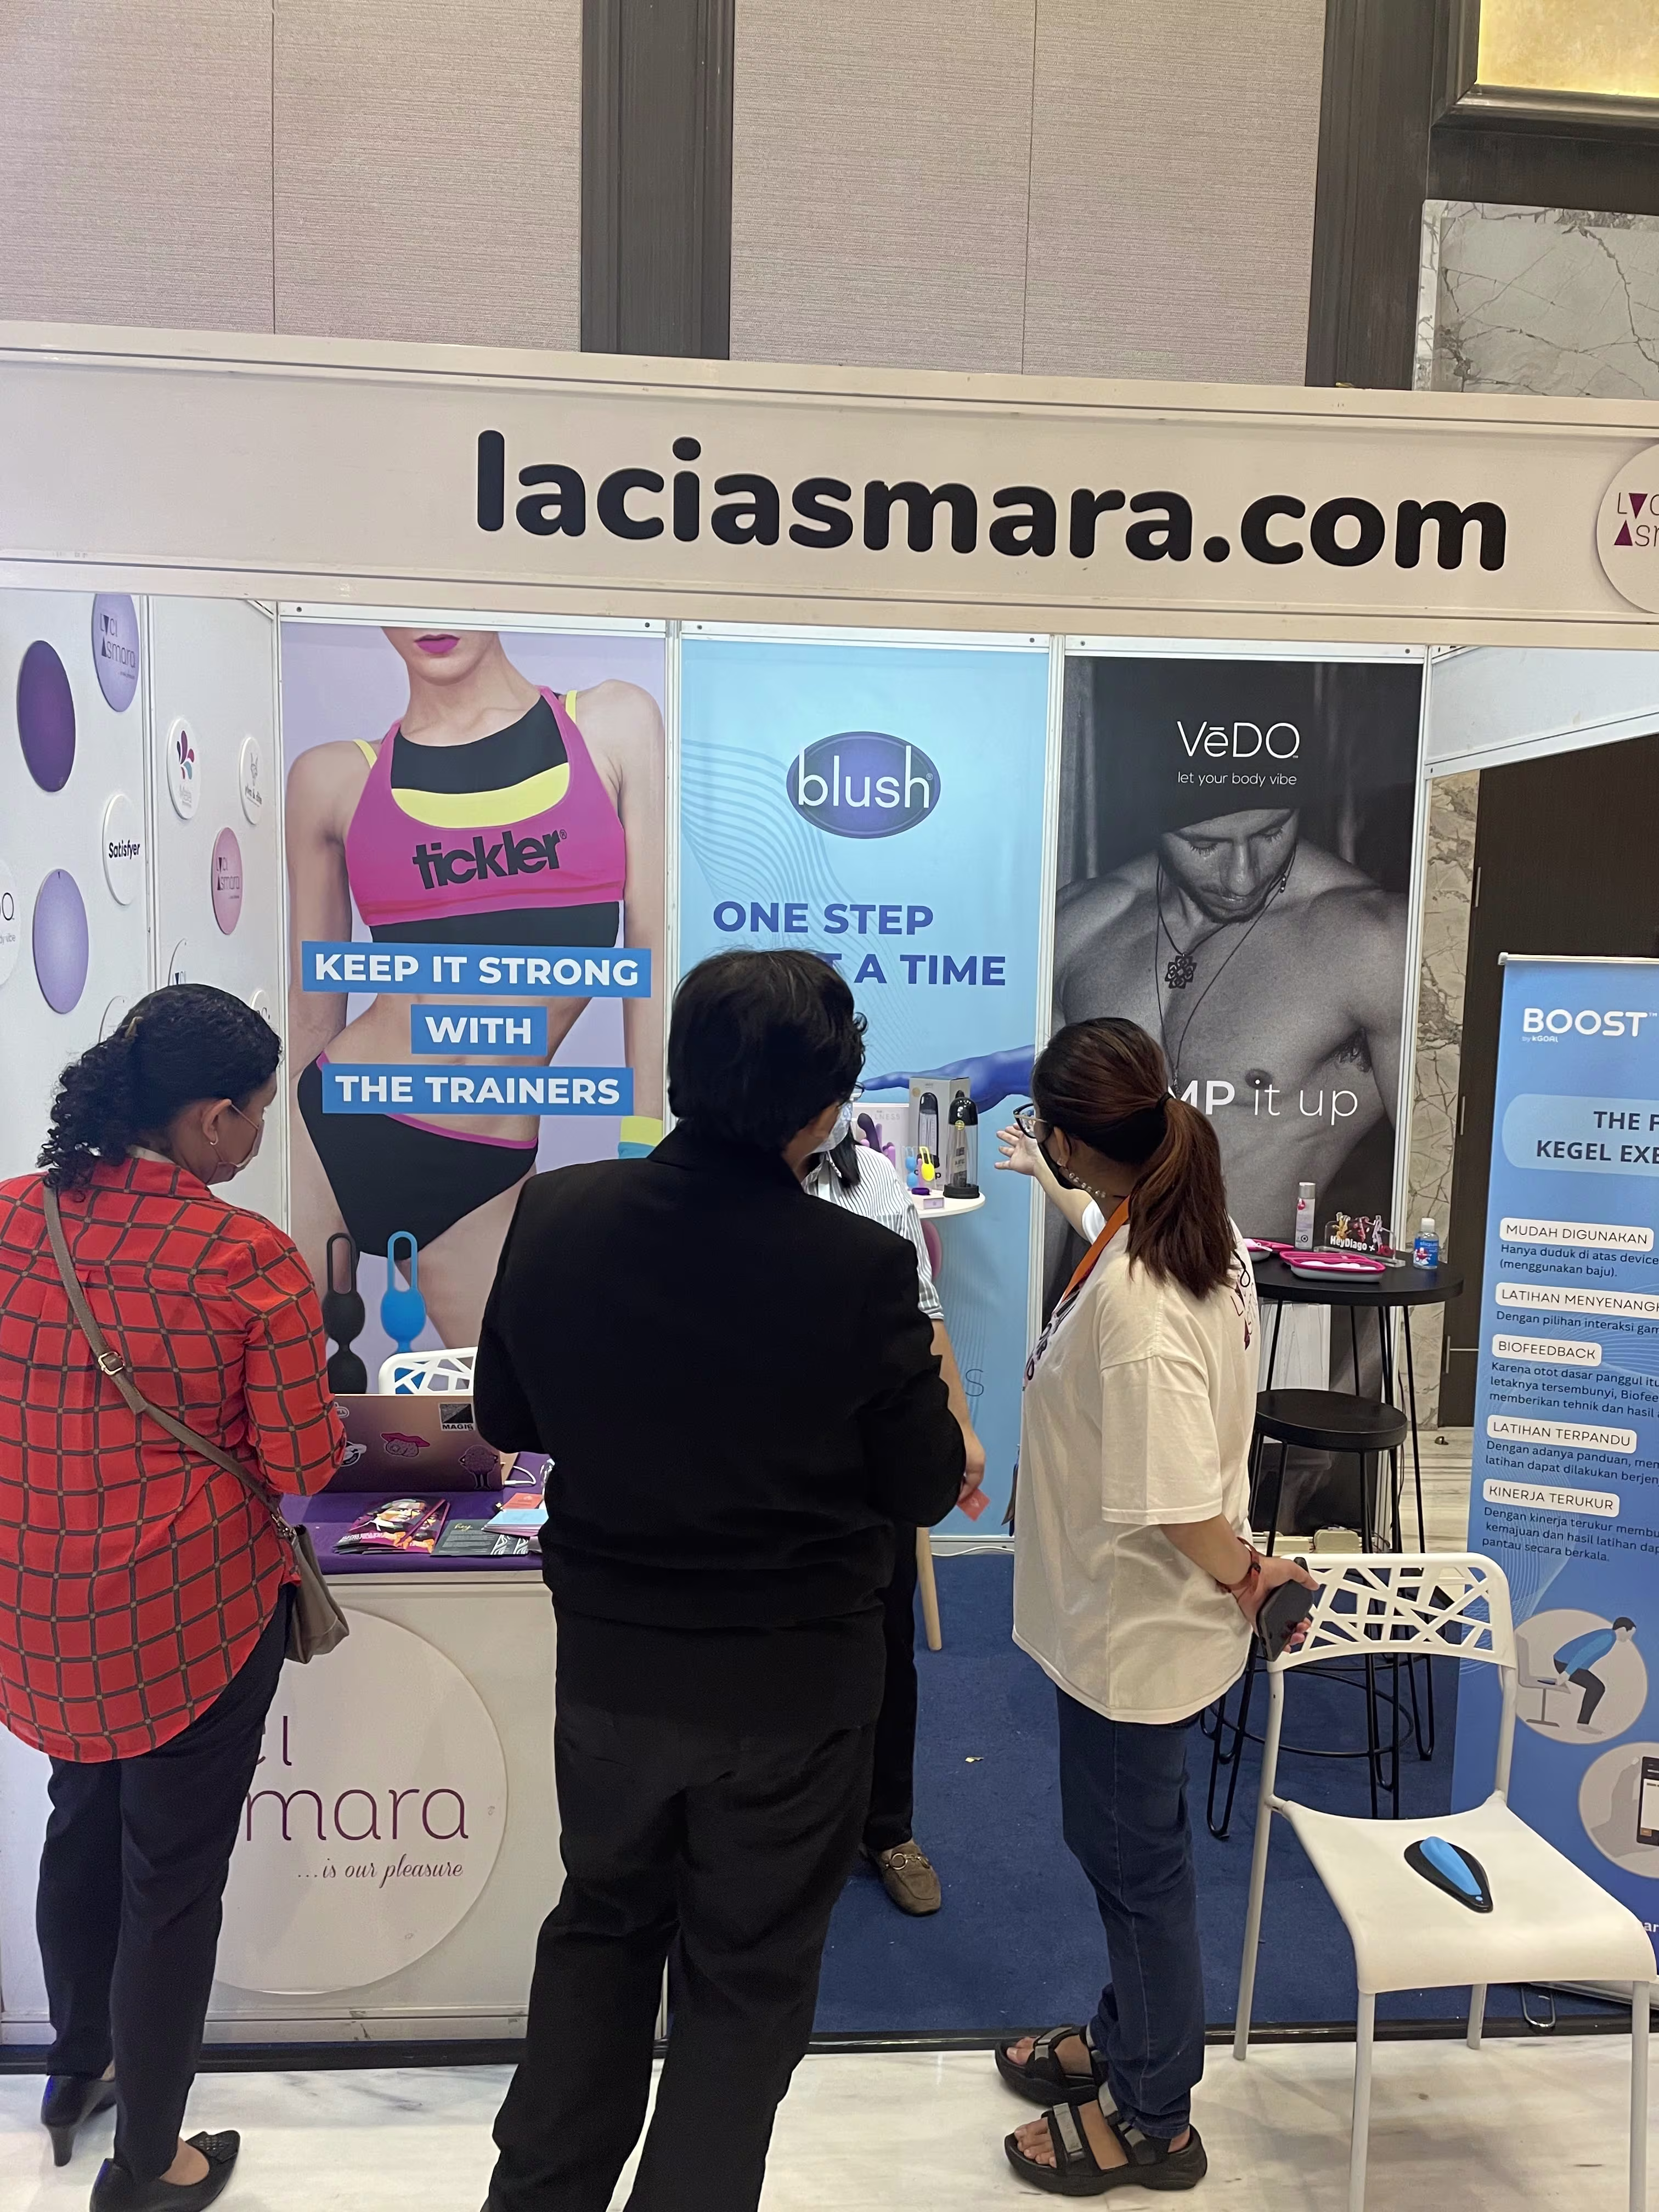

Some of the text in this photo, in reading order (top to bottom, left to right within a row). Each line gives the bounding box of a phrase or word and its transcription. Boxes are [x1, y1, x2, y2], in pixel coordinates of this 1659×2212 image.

[477, 430, 1506, 571] laciasmara.com
[1177, 771, 1297, 787] let your body vibe
[109, 839, 140, 860] Satisfyer
[713, 901, 933, 935] ONE STEP
[315, 953, 639, 986] KEEP IT STRONG
[854, 953, 888, 984] A
[900, 954, 1006, 986] TIME
[425, 1016, 532, 1044] WITH
[335, 1075, 620, 1105] THE TRAINERS
[1253, 1079, 1280, 1116] it
[1299, 1090, 1358, 1125] up
[1593, 1110, 1641, 1131] THE
[1536, 1140, 1611, 1161] KEGEL
[1506, 1224, 1647, 1244] MUDAH DIGUNAKAN
[1501, 1244, 1659, 1265] Hanya duduk di atas device
[1500, 1259, 1618, 1278] (menggunakan baju).
[1502, 1289, 1659, 1312] LATIHAN MENYENANG
[1497, 1311, 1540, 1325] Dengan
[1543, 1315, 1581, 1327] pilihan
[1585, 1318, 1634, 1331] interaksi
[1499, 1341, 1595, 1359] BIOFEEDBACK
[1492, 1362, 1531, 1374] Karena
[1534, 1367, 1558, 1377] otot
[1561, 1369, 1593, 1380] dasar
[1596, 1373, 1643, 1386] panggul
[1491, 1376, 1659, 1402] letaknya tersembunyi, Biofee
[1489, 1393, 1560, 1408] memberikan
[1563, 1400, 1599, 1412] tehnik
[1601, 1403, 1623, 1414] dan
[1627, 1406, 1654, 1418] hasil
[1493, 1421, 1630, 1446] LATIHAN TERPANDU
[1486, 1440, 1530, 1454] Dengan
[1532, 1447, 1574, 1460] adanya
[1577, 1452, 1631, 1468] panduan,
[1486, 1455, 1659, 1487] latihan dapat dilakukan berjen
[1489, 1486, 1613, 1510] KINERJA TERUKUR
[1484, 1507, 1526, 1521] Dengan
[1530, 1513, 1567, 1527] kinerja
[1571, 1518, 1612, 1531] terukur
[1486, 1523, 1539, 1537] kemajuan
[1543, 1530, 1564, 1540] dan
[1567, 1532, 1594, 1544] hasil
[1596, 1534, 1637, 1550] latihan
[1482, 1538, 1610, 1562] pantau secara berkala.
[345, 1862, 376, 1878] our
[379, 1853, 464, 1889] pleasure
